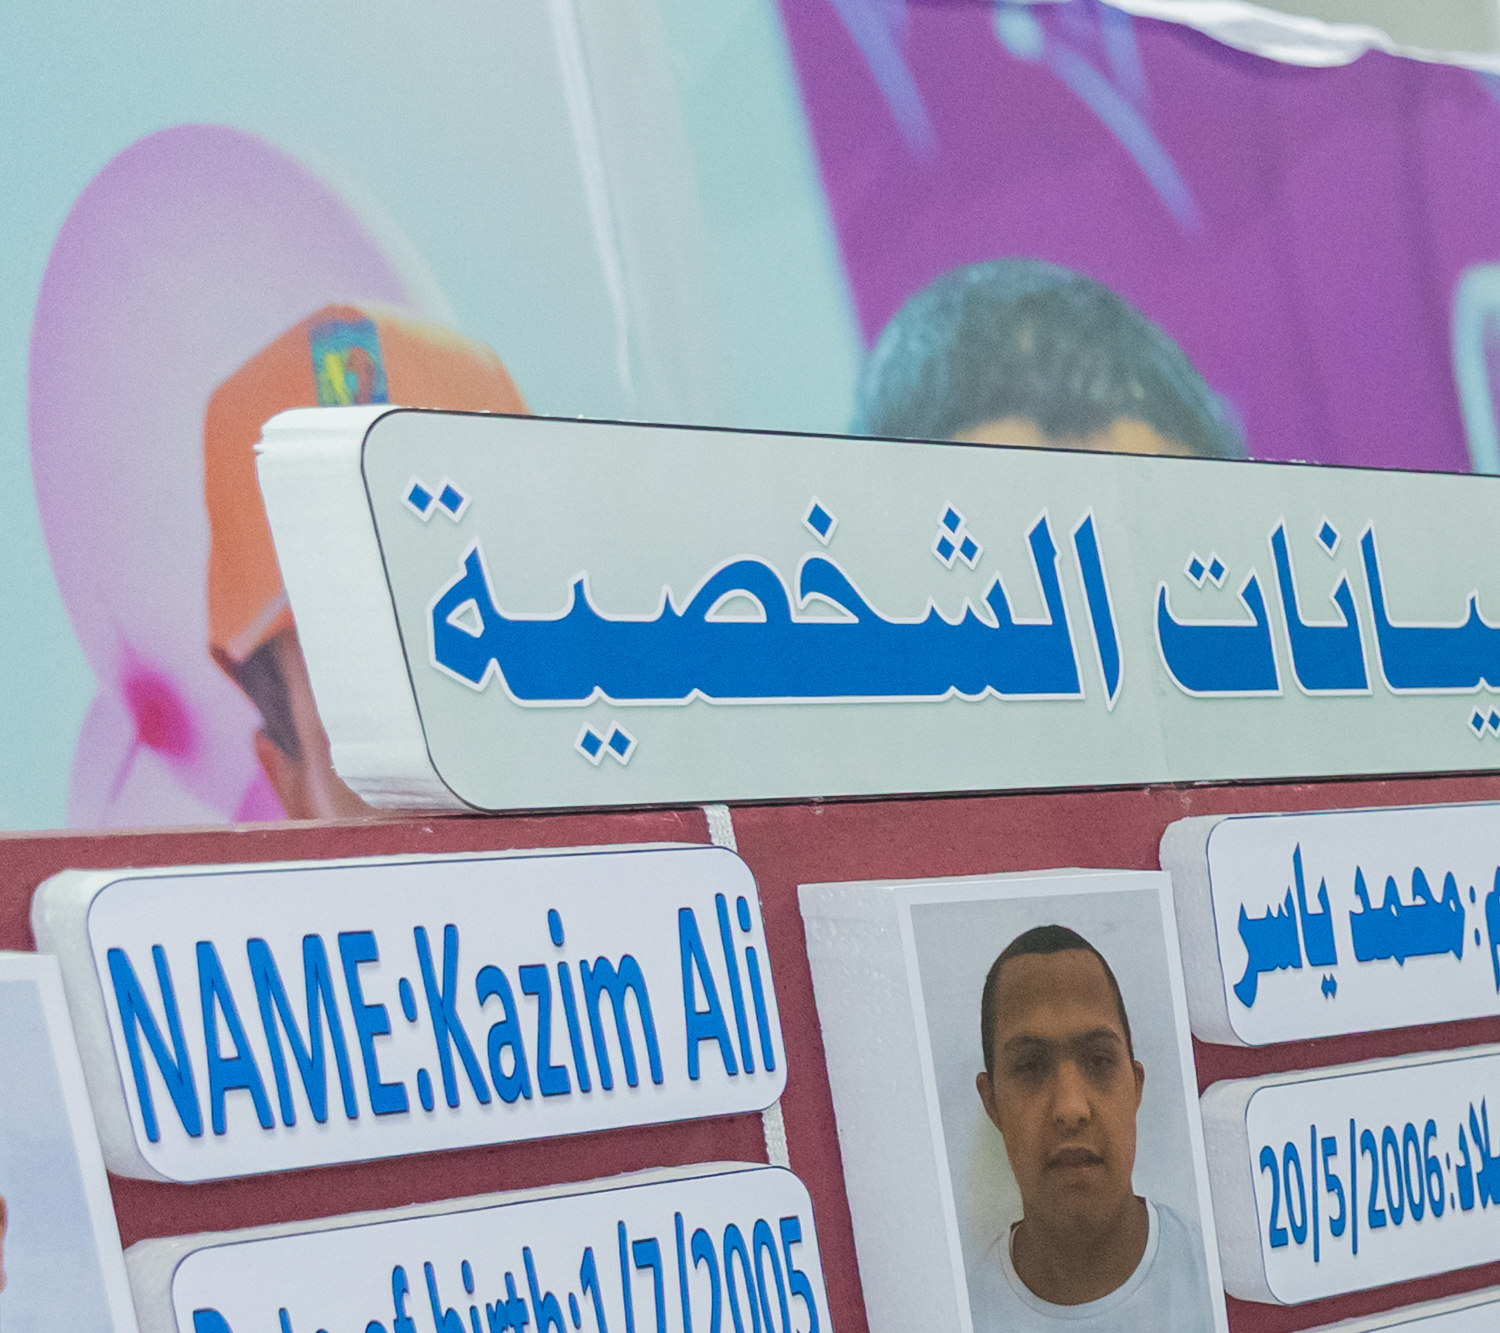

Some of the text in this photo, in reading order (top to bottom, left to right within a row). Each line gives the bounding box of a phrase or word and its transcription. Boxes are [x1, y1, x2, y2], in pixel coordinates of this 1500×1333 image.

[401, 474, 1127, 765] الشخصية
[105, 891, 777, 1146] NAME:Kazim Ali
[1231, 844, 1339, 1010] ياسر
